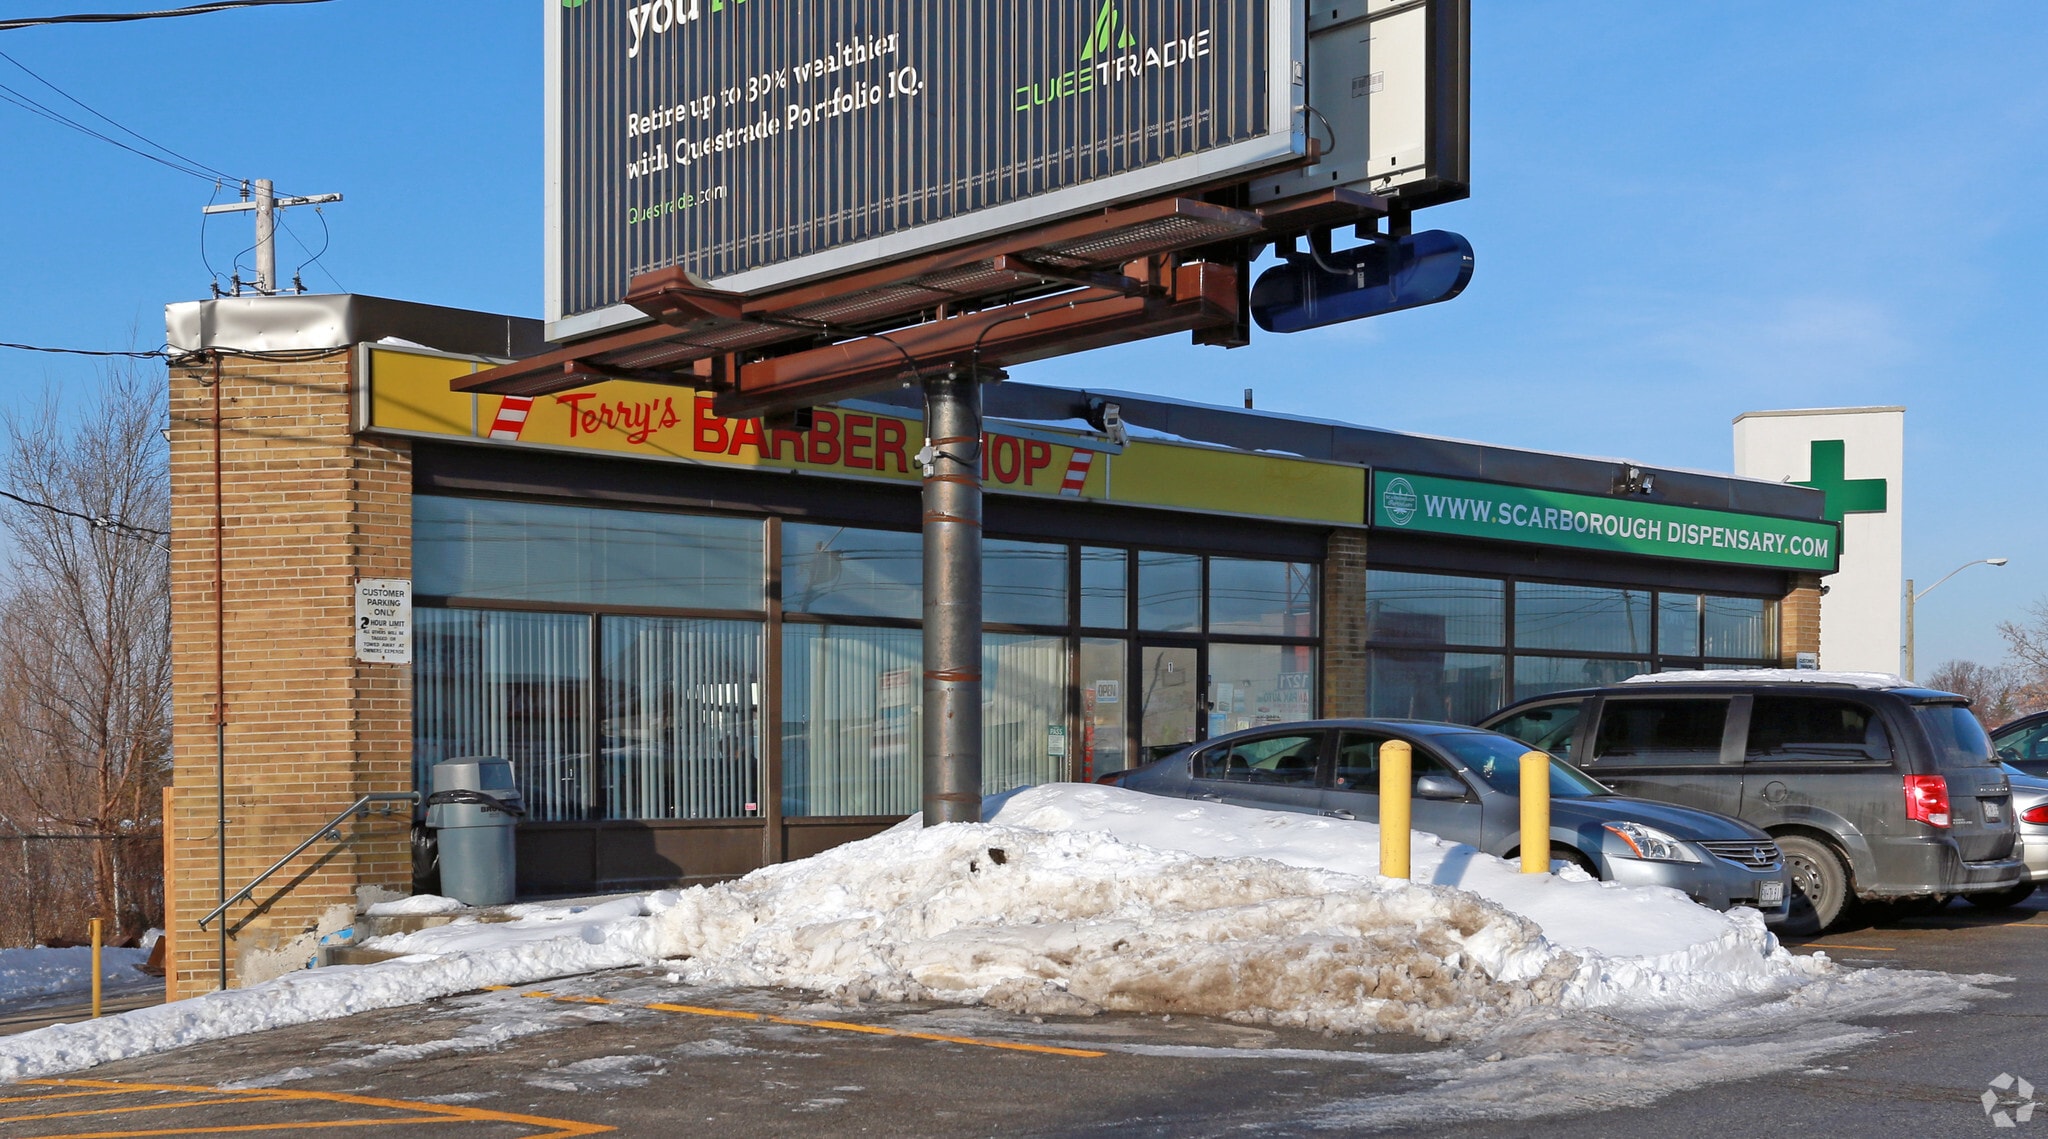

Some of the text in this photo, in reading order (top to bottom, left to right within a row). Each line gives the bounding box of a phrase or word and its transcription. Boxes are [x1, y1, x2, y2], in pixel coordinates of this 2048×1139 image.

[627, 0, 699, 58] you
[628, 32, 900, 138] Retire up to 30% wealthier
[1011, 29, 1210, 111] QUESTRADE
[627, 66, 924, 180] with Questrade Portfolio IQ.
[628, 184, 728, 224] Questrade.com
[556, 393, 681, 445] Terry's
[982, 431, 1052, 486] OP
[1423, 494, 1829, 558] WWW.SCARBOROUGH DISPENSARY.COM
[362, 588, 405, 598] CUSTOMER
[367, 598, 401, 607] PARKING
[374, 608, 396, 616] ONLY
[360, 616, 370, 629] 2
[370, 619, 387, 627] HOUR
[1098, 684, 1117, 697] OPEN
